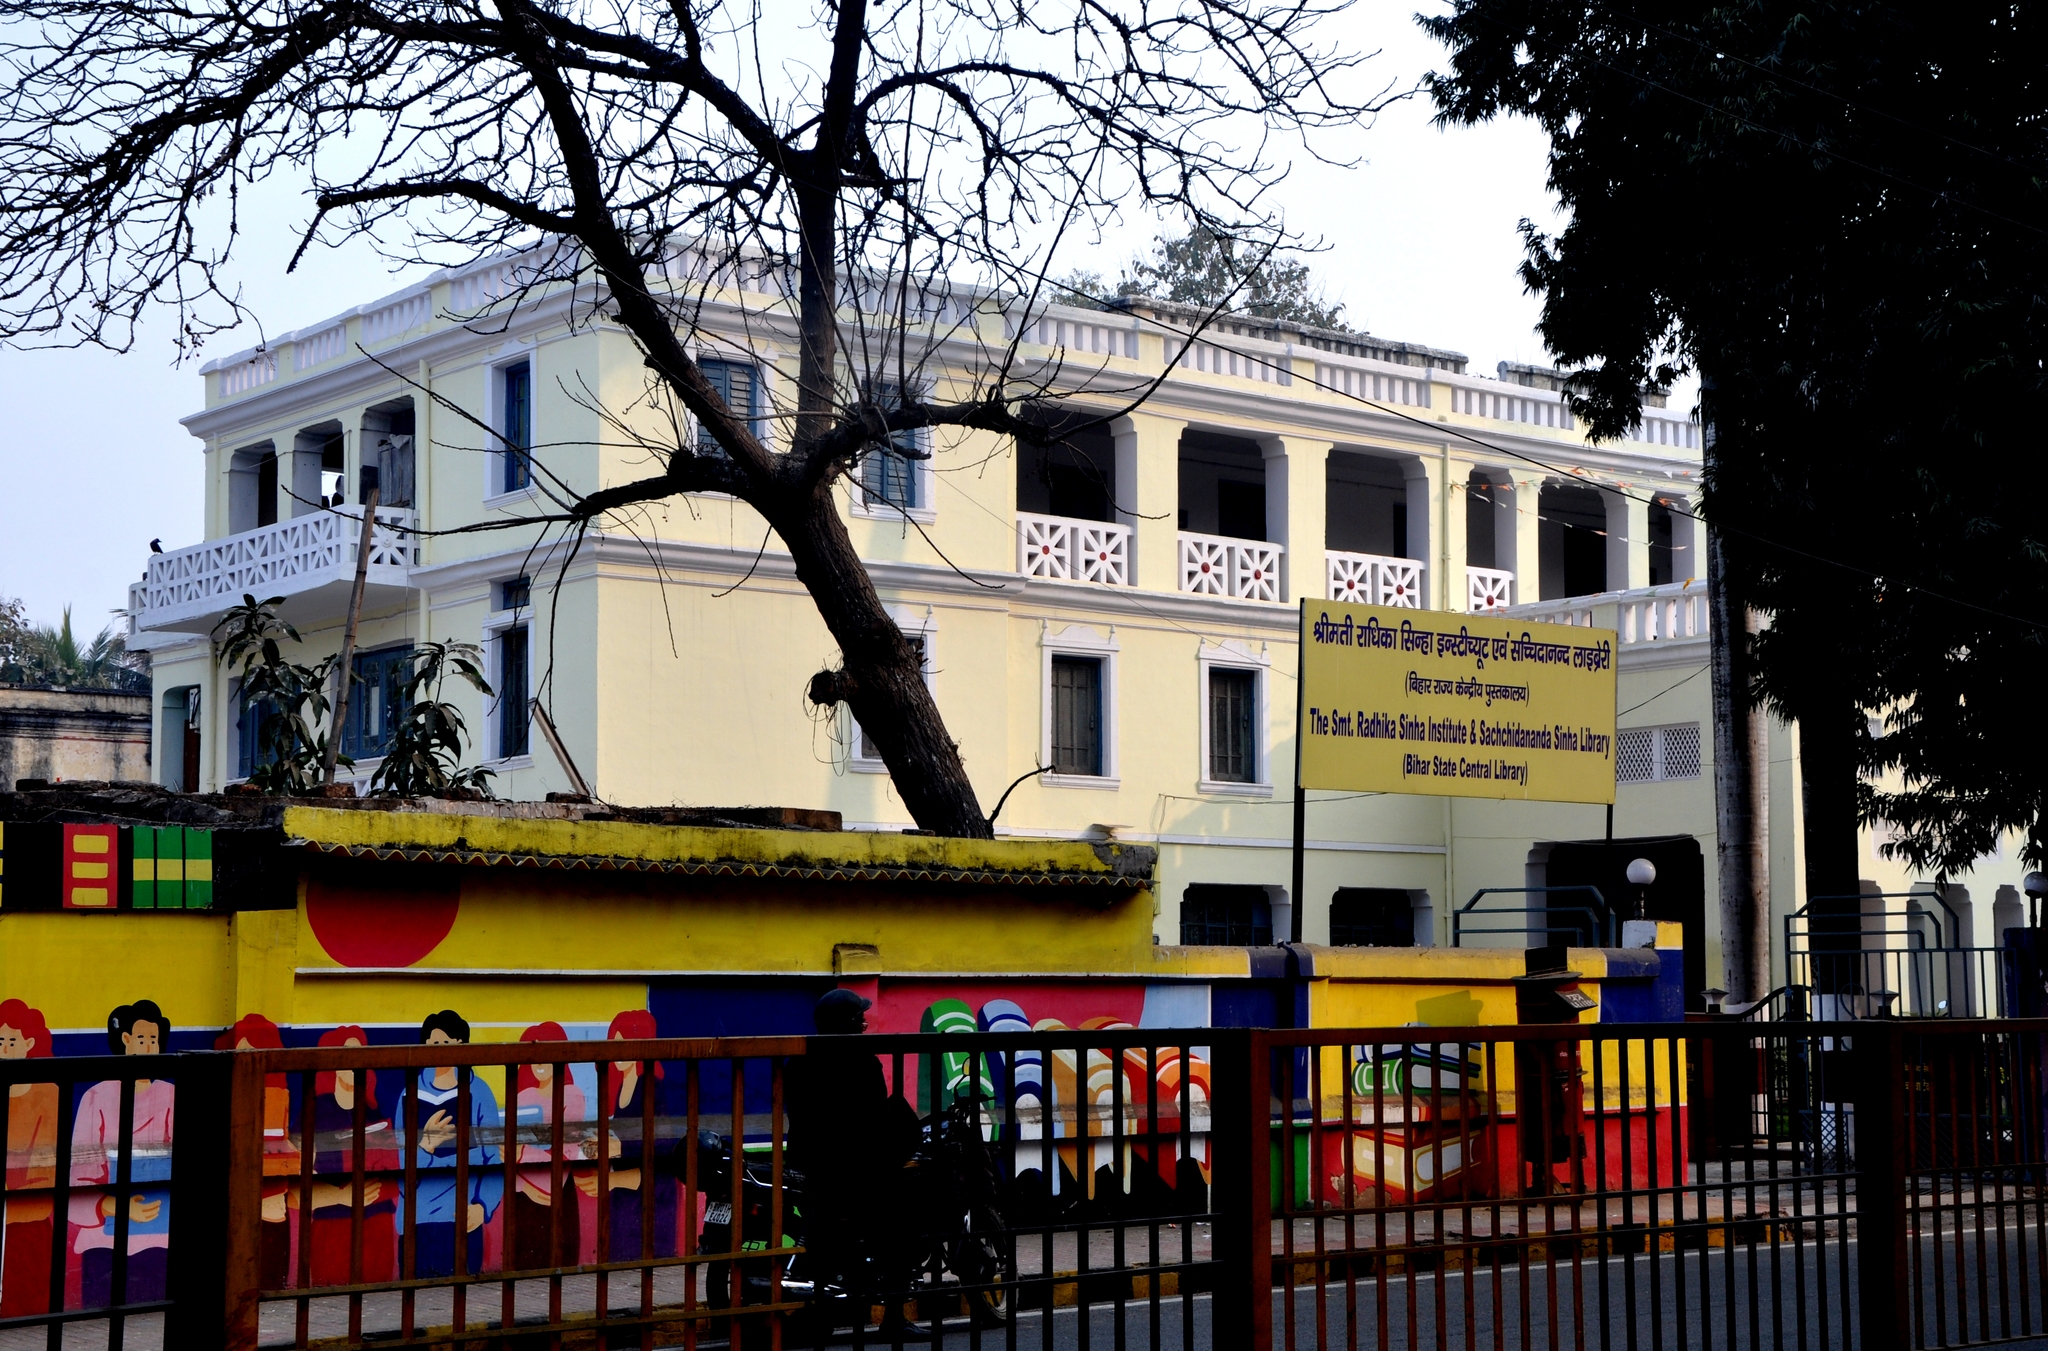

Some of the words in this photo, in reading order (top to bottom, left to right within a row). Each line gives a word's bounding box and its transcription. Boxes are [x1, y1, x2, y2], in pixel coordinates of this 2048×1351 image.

[1313, 612, 1354, 646] श्रीमती
[1356, 617, 1398, 650] राधिका
[1400, 620, 1434, 656] सिन्हा
[1492, 631, 1509, 661] एवं
[1511, 632, 1571, 665] सच्चिदानन्द
[1573, 640, 1611, 672] लाइब्रेरी
[1405, 671, 1432, 698] (बिहार
[1434, 680, 1453, 696] राज्य
[1455, 676, 1483, 700] केन्द्रीय
[1485, 681, 1530, 707] पुस्तकालय)
[1310, 707, 1329, 736] The
[1331, 709, 1354, 737] Smt.
[1357, 711, 1396, 739] Radhika
[1399, 713, 1425, 741] Sinha
[1428, 715, 1467, 744] Institute
[1470, 718, 1477, 745] &
[1479, 719, 1552, 750] Sachchidananda
[1554, 724, 1578, 752] Sinha
[1580, 726, 1611, 760] Library
[1403, 753, 1431, 780] (Bihar
[1433, 755, 1457, 777] State
[1459, 757, 1492, 779] Central
[1494, 759, 1528, 786] Library)
